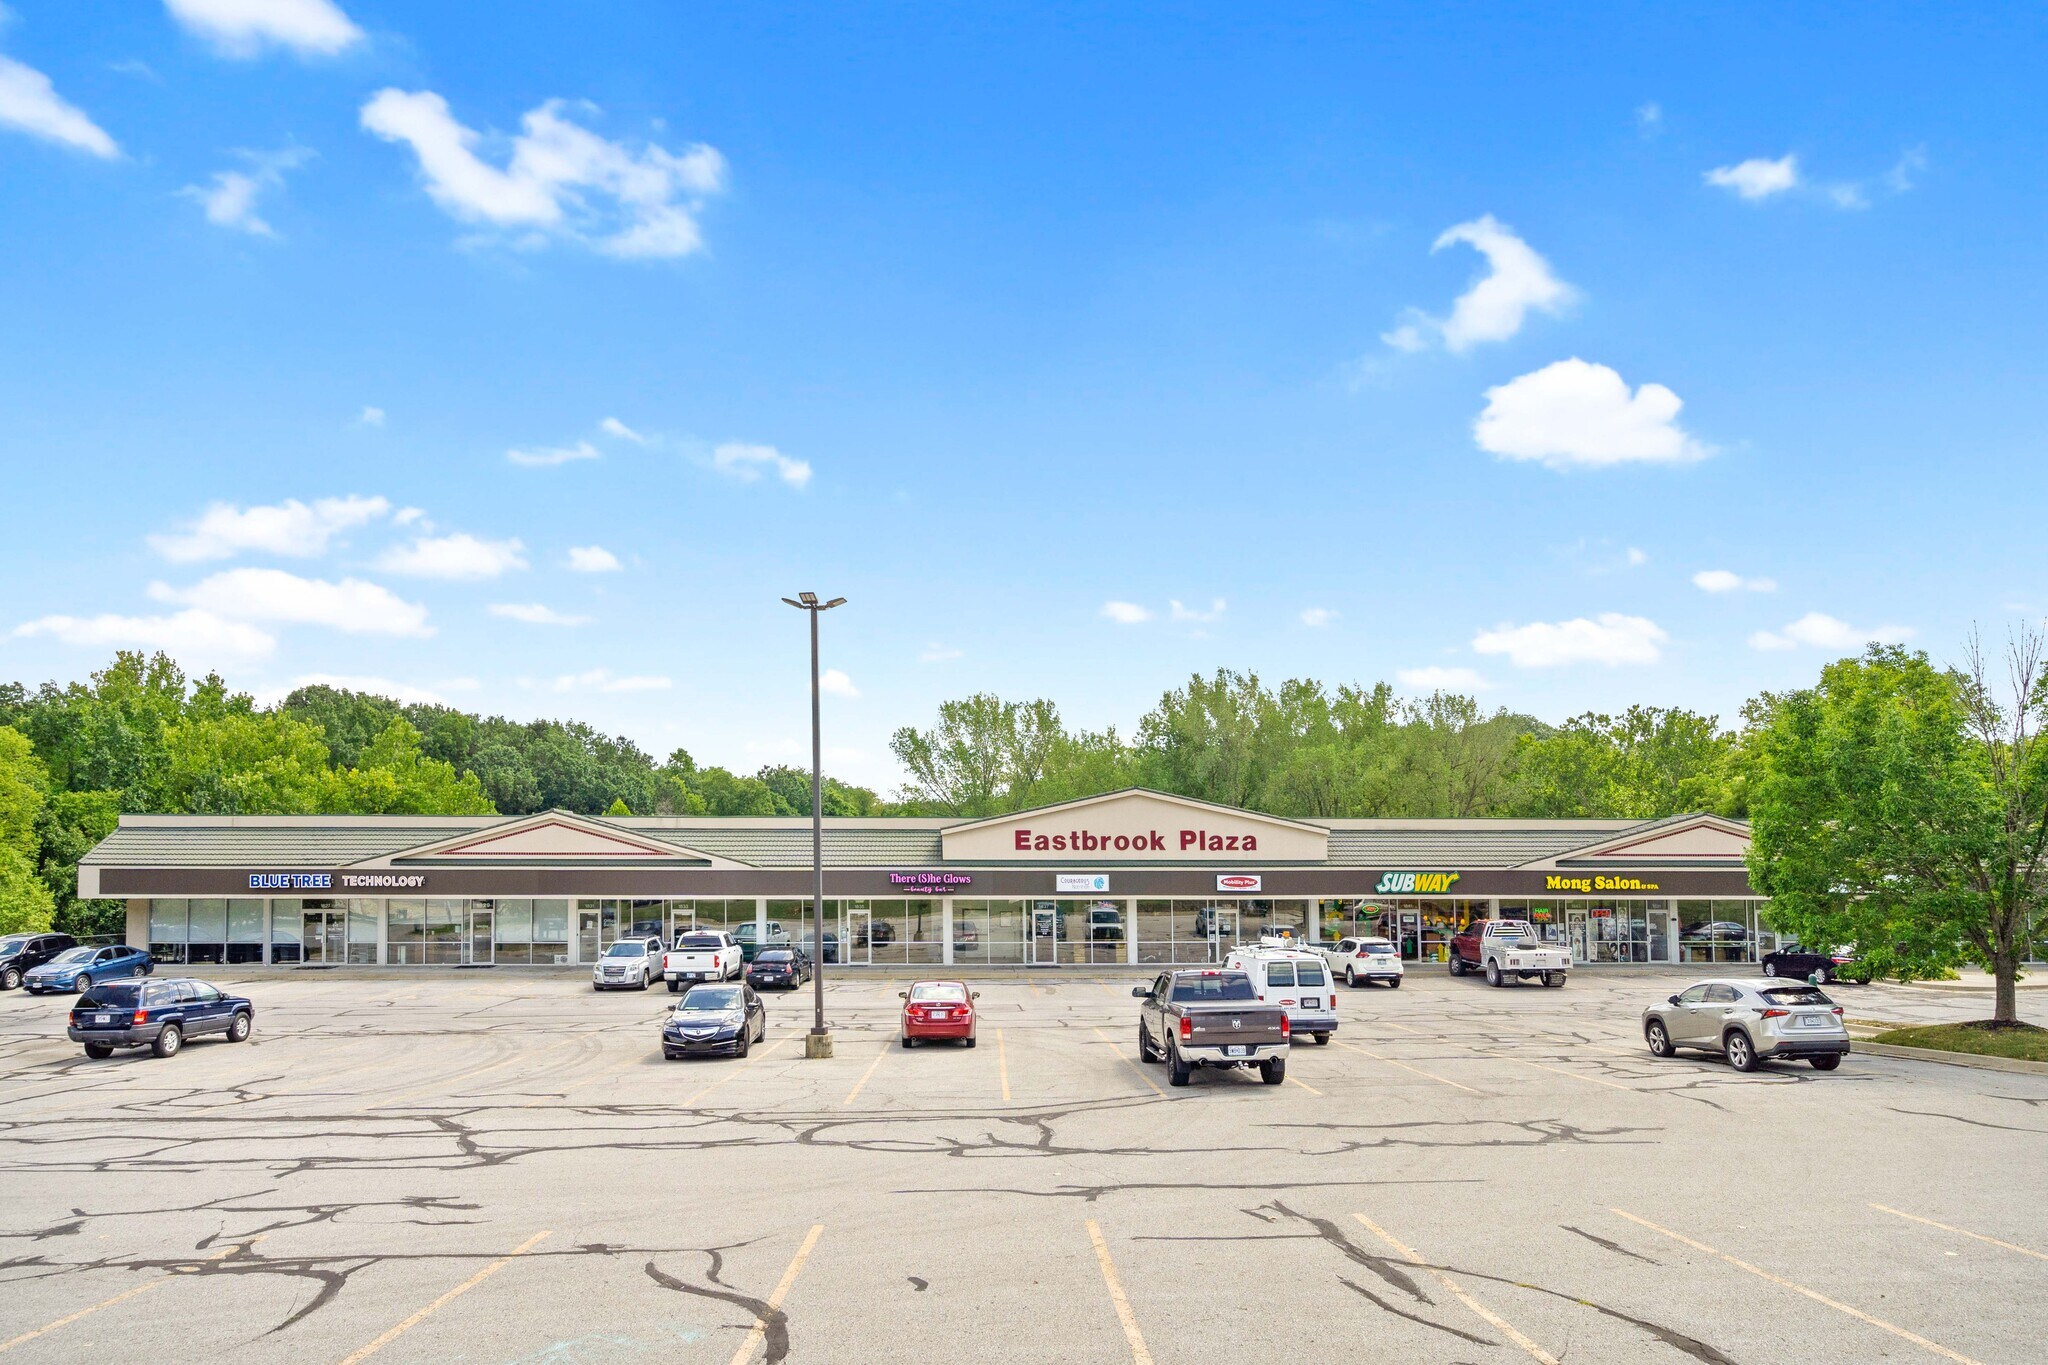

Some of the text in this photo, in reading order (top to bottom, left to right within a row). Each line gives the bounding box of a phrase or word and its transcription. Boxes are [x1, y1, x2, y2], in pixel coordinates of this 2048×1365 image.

[1014, 829, 1258, 851] Eastbrook Plaza
[249, 873, 425, 889] BLUE TREE TECHNOLOGY
[889, 873, 971, 884] There (S)he Glows
[1376, 871, 1460, 893] SUBWAY
[1545, 875, 1592, 893] Mong
[1594, 875, 1641, 890] Salon
